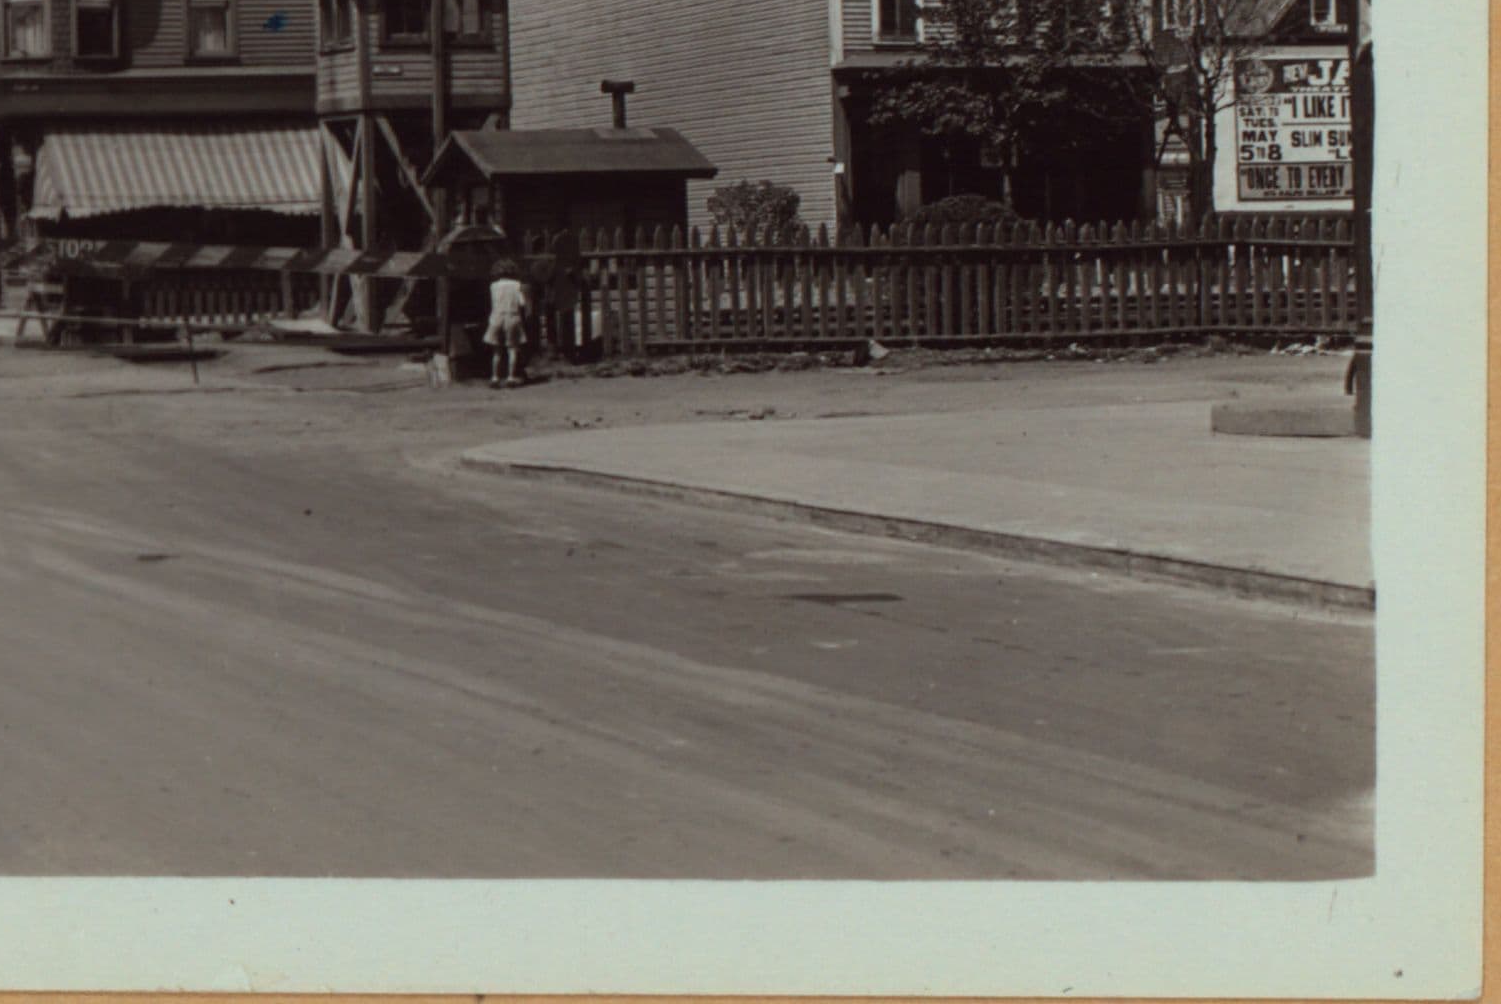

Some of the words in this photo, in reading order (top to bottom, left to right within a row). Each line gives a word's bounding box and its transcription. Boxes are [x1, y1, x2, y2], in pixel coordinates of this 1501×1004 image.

[1304, 95, 1335, 118] LIKE
[1242, 130, 1278, 142] MAY
[1240, 145, 1254, 160] 5
[1268, 144, 1282, 160] 8
